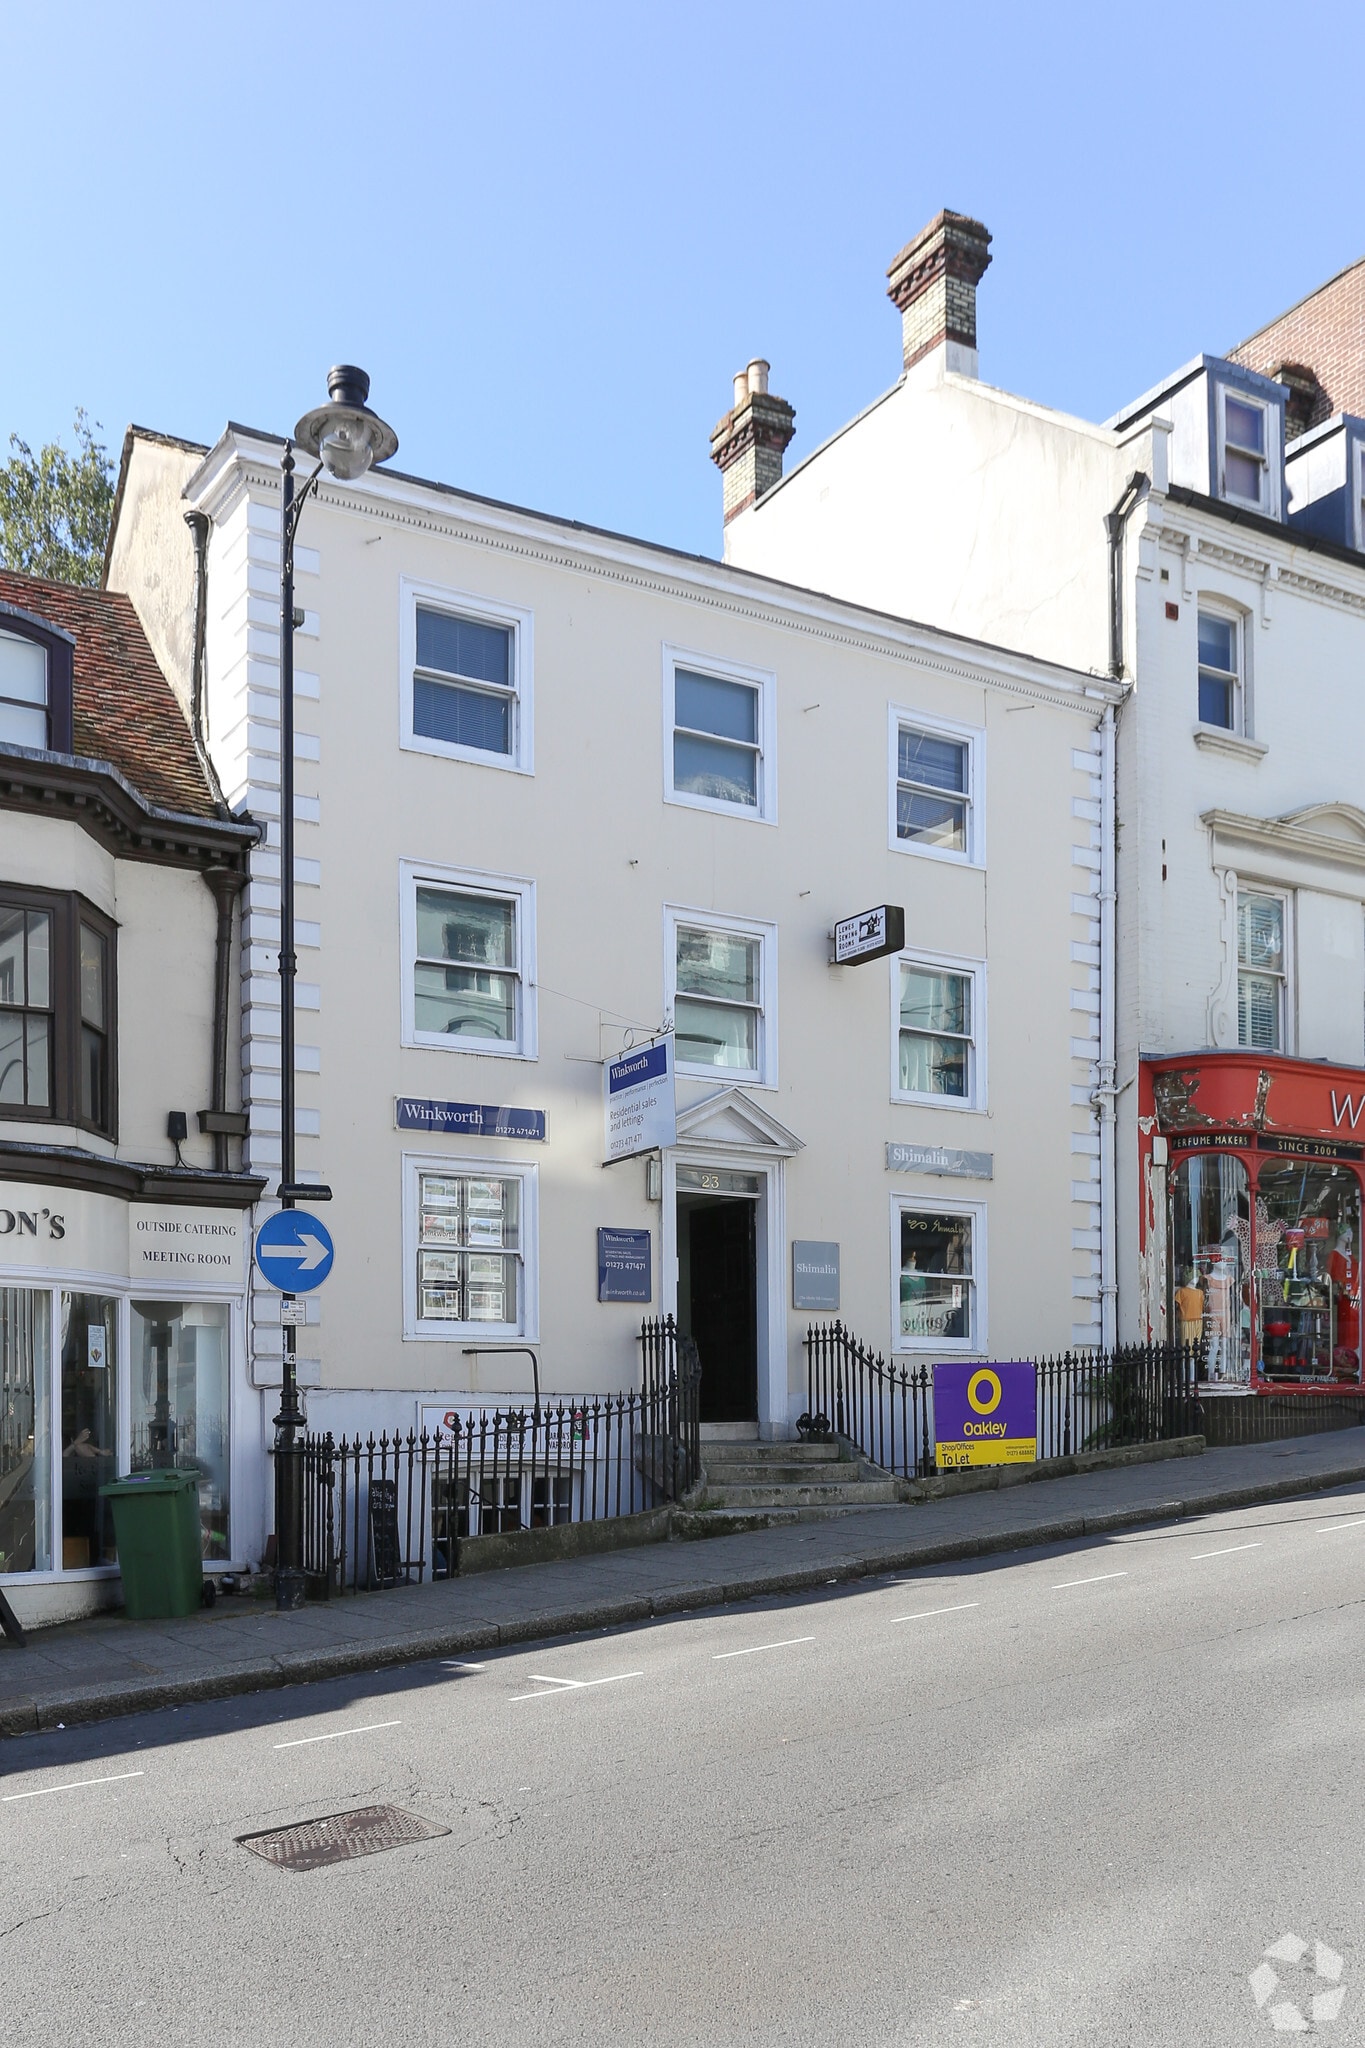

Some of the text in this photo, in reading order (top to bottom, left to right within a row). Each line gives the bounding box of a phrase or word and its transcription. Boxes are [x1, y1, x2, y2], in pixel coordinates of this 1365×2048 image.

[839, 923, 854, 934] LEWES
[838, 930, 858, 943] SEWING
[839, 940, 855, 950] ROOMS
[611, 1056, 649, 1080] Winkworth
[404, 1103, 484, 1124] Winkworth
[610, 1097, 657, 1120] Residential sales
[610, 1114, 645, 1132] and lettings
[495, 1126, 540, 1137] 01273 471471
[610, 1138, 625, 1150] 01273
[1173, 1135, 1248, 1148] PERFUME MAKERS
[1278, 1141, 1338, 1157] SINCE 2004
[893, 1147, 949, 1165] Shimalin
[701, 1175, 720, 1189] 23
[136, 1220, 237, 1237] OUTSIDE CATERING
[605, 1234, 635, 1243] Winkworth
[142, 1250, 232, 1266] MEETING ROOM
[605, 1261, 646, 1271] 01273 471471
[796, 1263, 837, 1274] Shimalin
[605, 1288, 646, 1297] winkworth.co.uk
[963, 1421, 1007, 1438] Oakley
[942, 1442, 975, 1452] Shop/Offices
[942, 1453, 970, 1466] To Let
